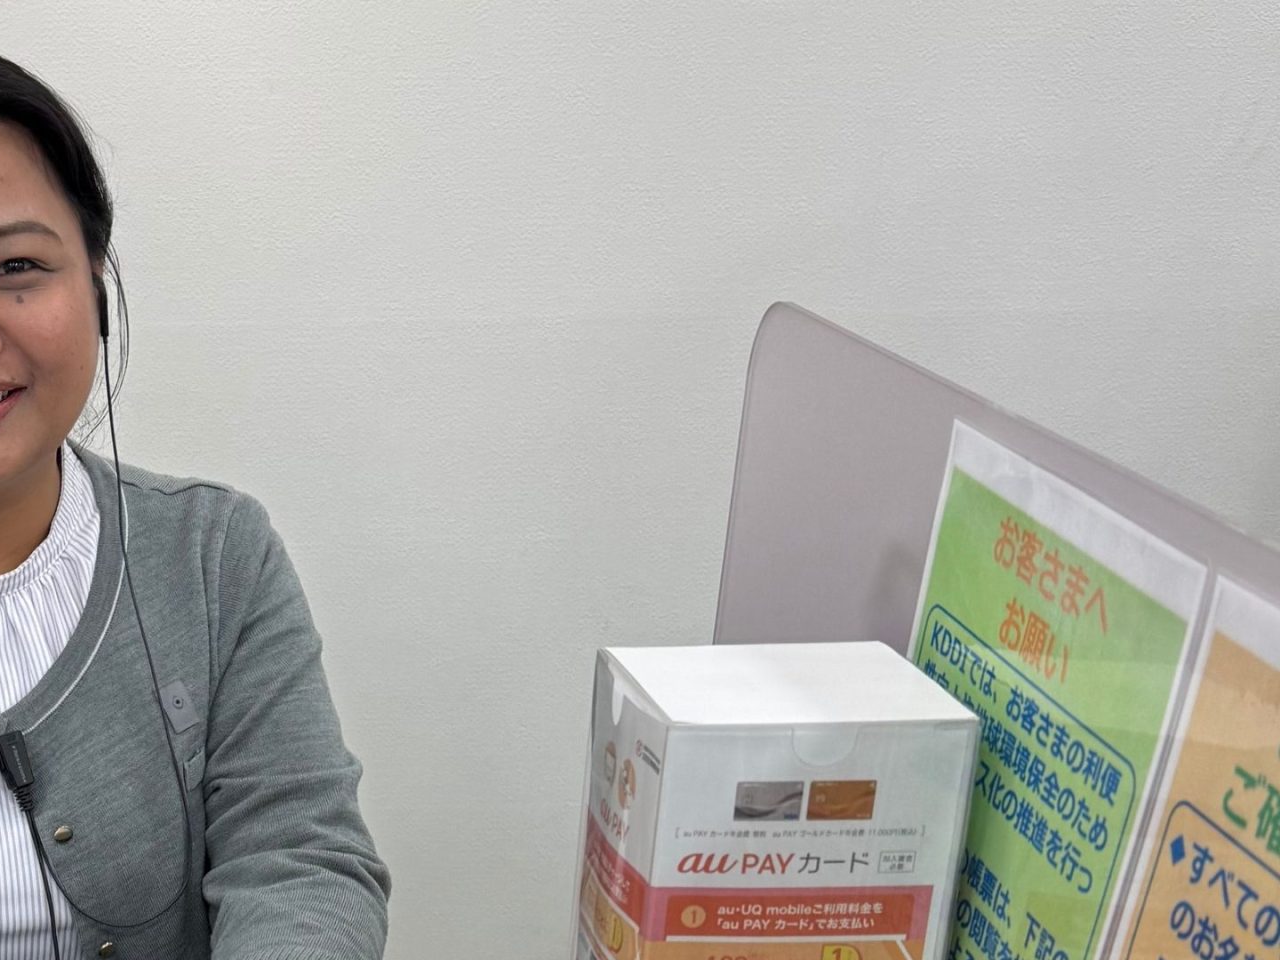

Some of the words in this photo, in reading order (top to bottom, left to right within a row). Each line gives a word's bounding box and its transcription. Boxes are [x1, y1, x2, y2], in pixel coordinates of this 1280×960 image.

[994, 516, 1108, 636] お客さまへ
[999, 597, 1069, 684] お願い
[677, 853, 737, 874] au
[741, 853, 795, 874] PAY
[798, 852, 869, 874] カード
[747, 919, 771, 930] PAY
